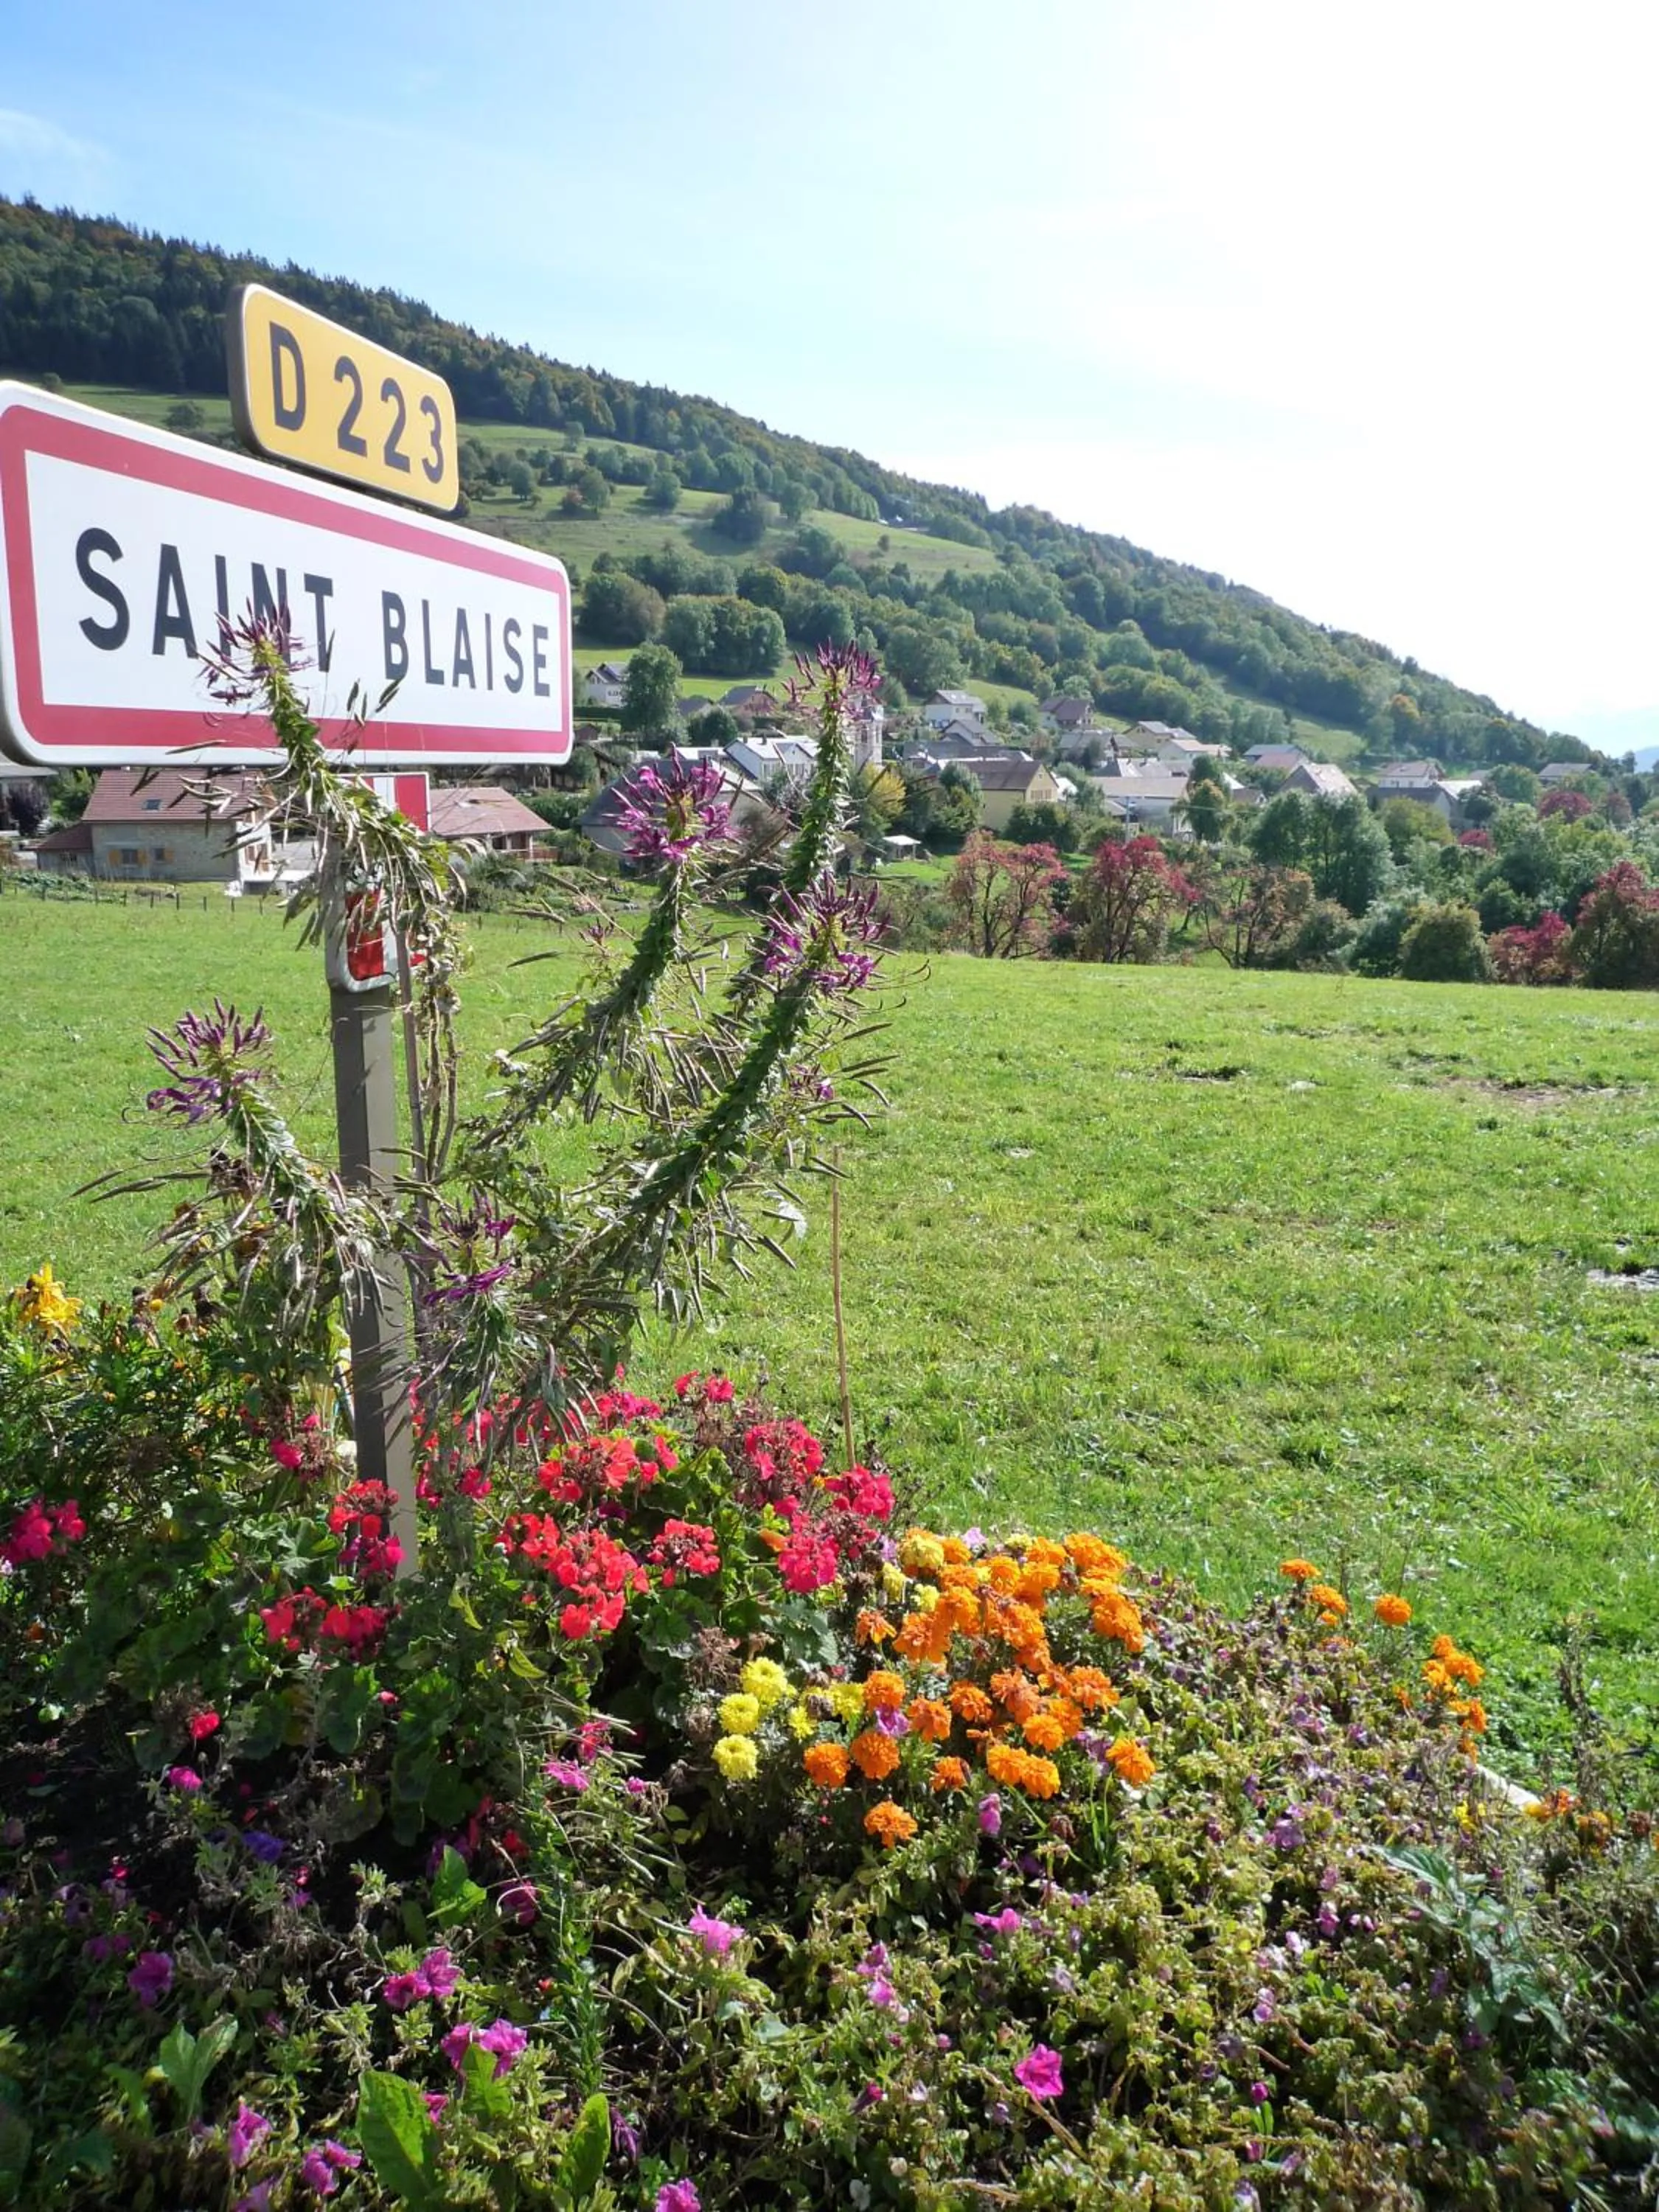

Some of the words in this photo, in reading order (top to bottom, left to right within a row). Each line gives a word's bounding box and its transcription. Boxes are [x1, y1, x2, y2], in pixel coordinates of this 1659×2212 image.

[269, 321, 306, 431] D
[334, 355, 444, 484] 223
[75, 526, 333, 673] SAINT
[381, 590, 551, 698] BLAISE
